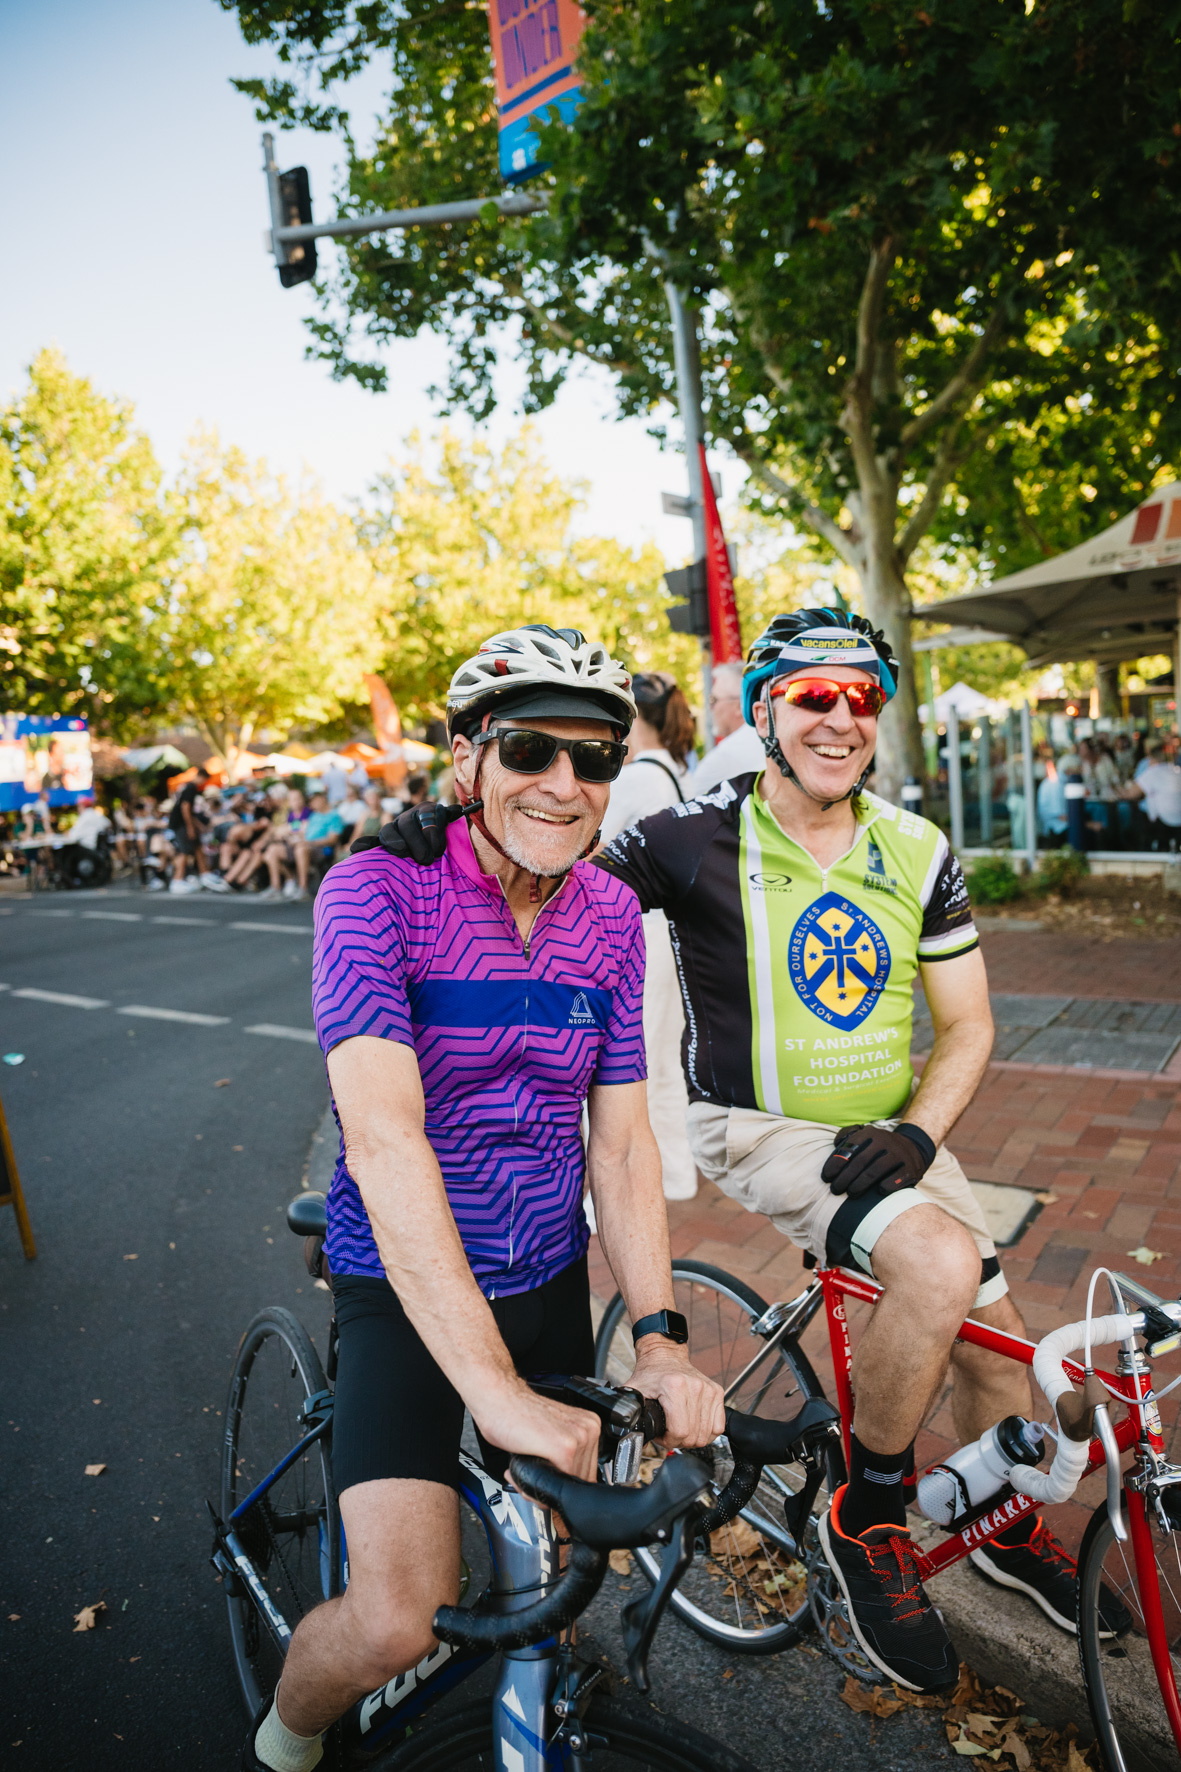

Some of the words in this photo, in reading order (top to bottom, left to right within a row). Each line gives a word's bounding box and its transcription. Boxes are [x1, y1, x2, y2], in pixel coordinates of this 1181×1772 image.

[792, 906, 820, 970] OURSELVES
[855, 914, 888, 966] ANDREWS
[794, 975, 811, 999] FOR
[855, 970, 887, 1017] HOSPITAL
[810, 1002, 834, 1021] NOT
[785, 1038, 806, 1051] ST
[813, 1027, 899, 1051] ANDREW'S
[793, 1058, 903, 1087] FOUNDATION
[810, 1048, 892, 1069] HOSPITAL
[961, 1492, 1037, 1547] PINARE
